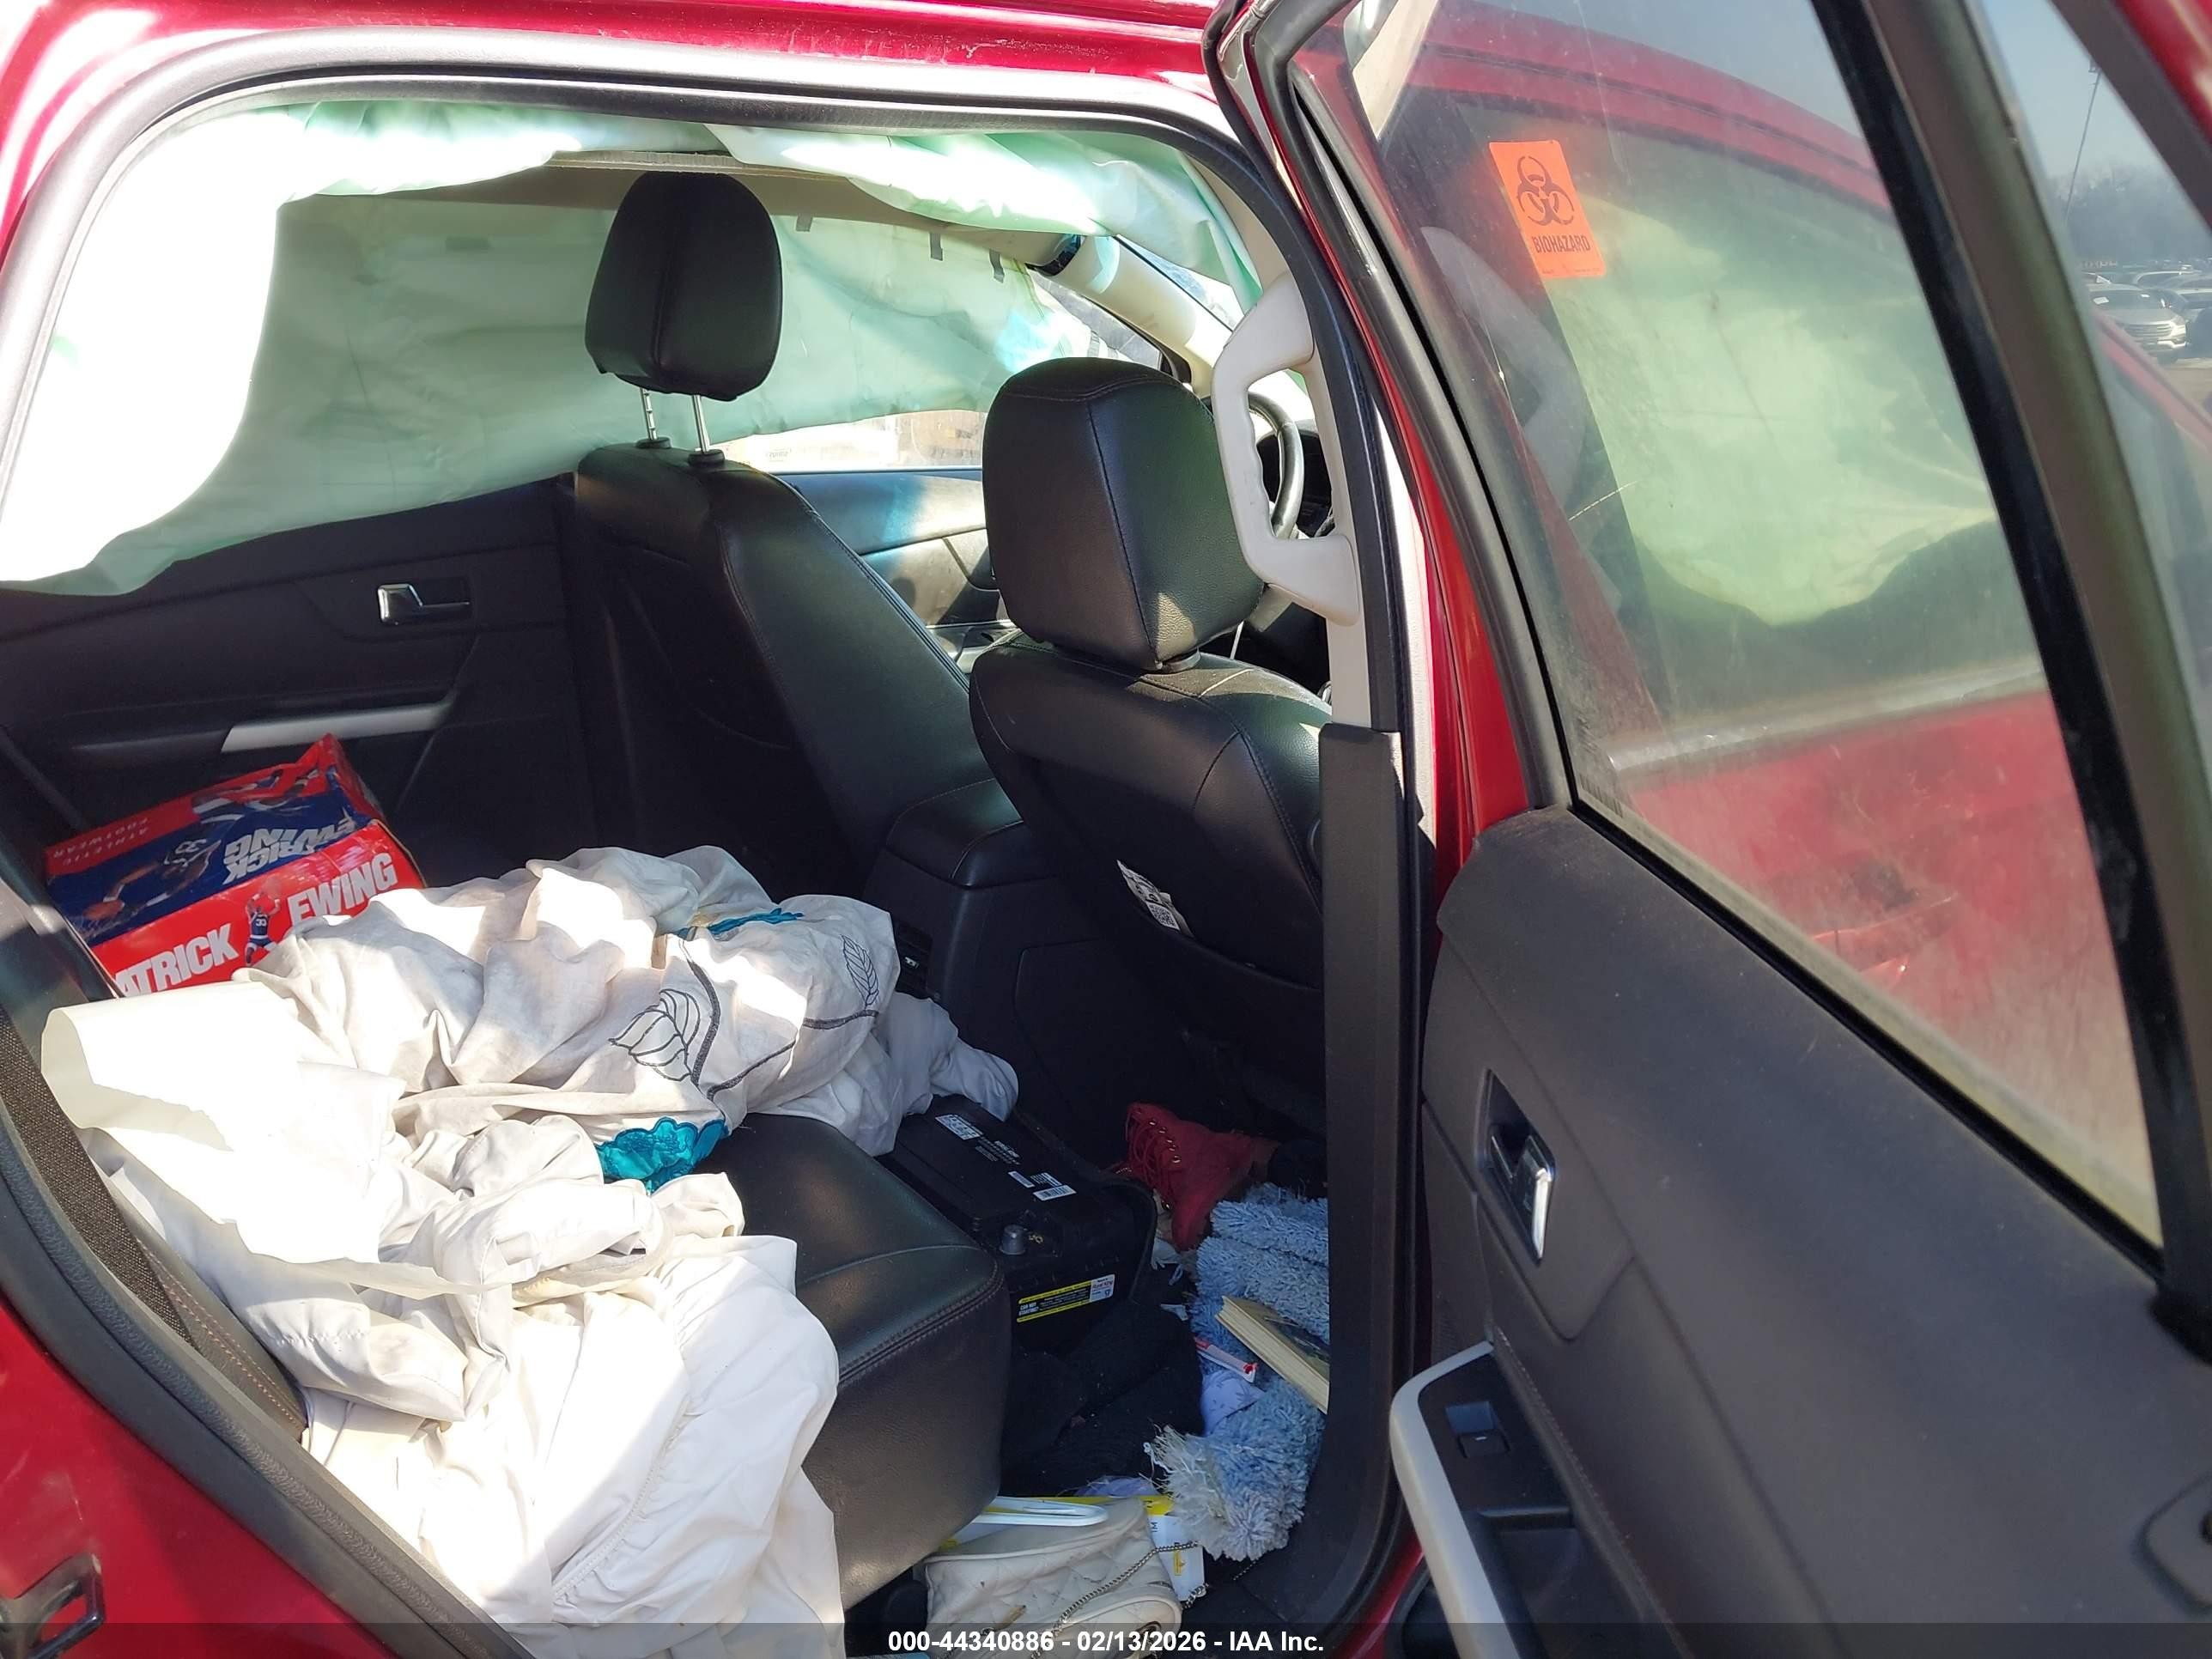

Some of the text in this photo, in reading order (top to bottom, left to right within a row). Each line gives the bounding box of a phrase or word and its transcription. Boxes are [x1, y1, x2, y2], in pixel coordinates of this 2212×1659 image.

[1532, 234, 1590, 253] BIOHAZARD
[224, 805, 357, 865] EWING
[288, 853, 398, 927] EWING
[115, 923, 240, 997] ATRICK
